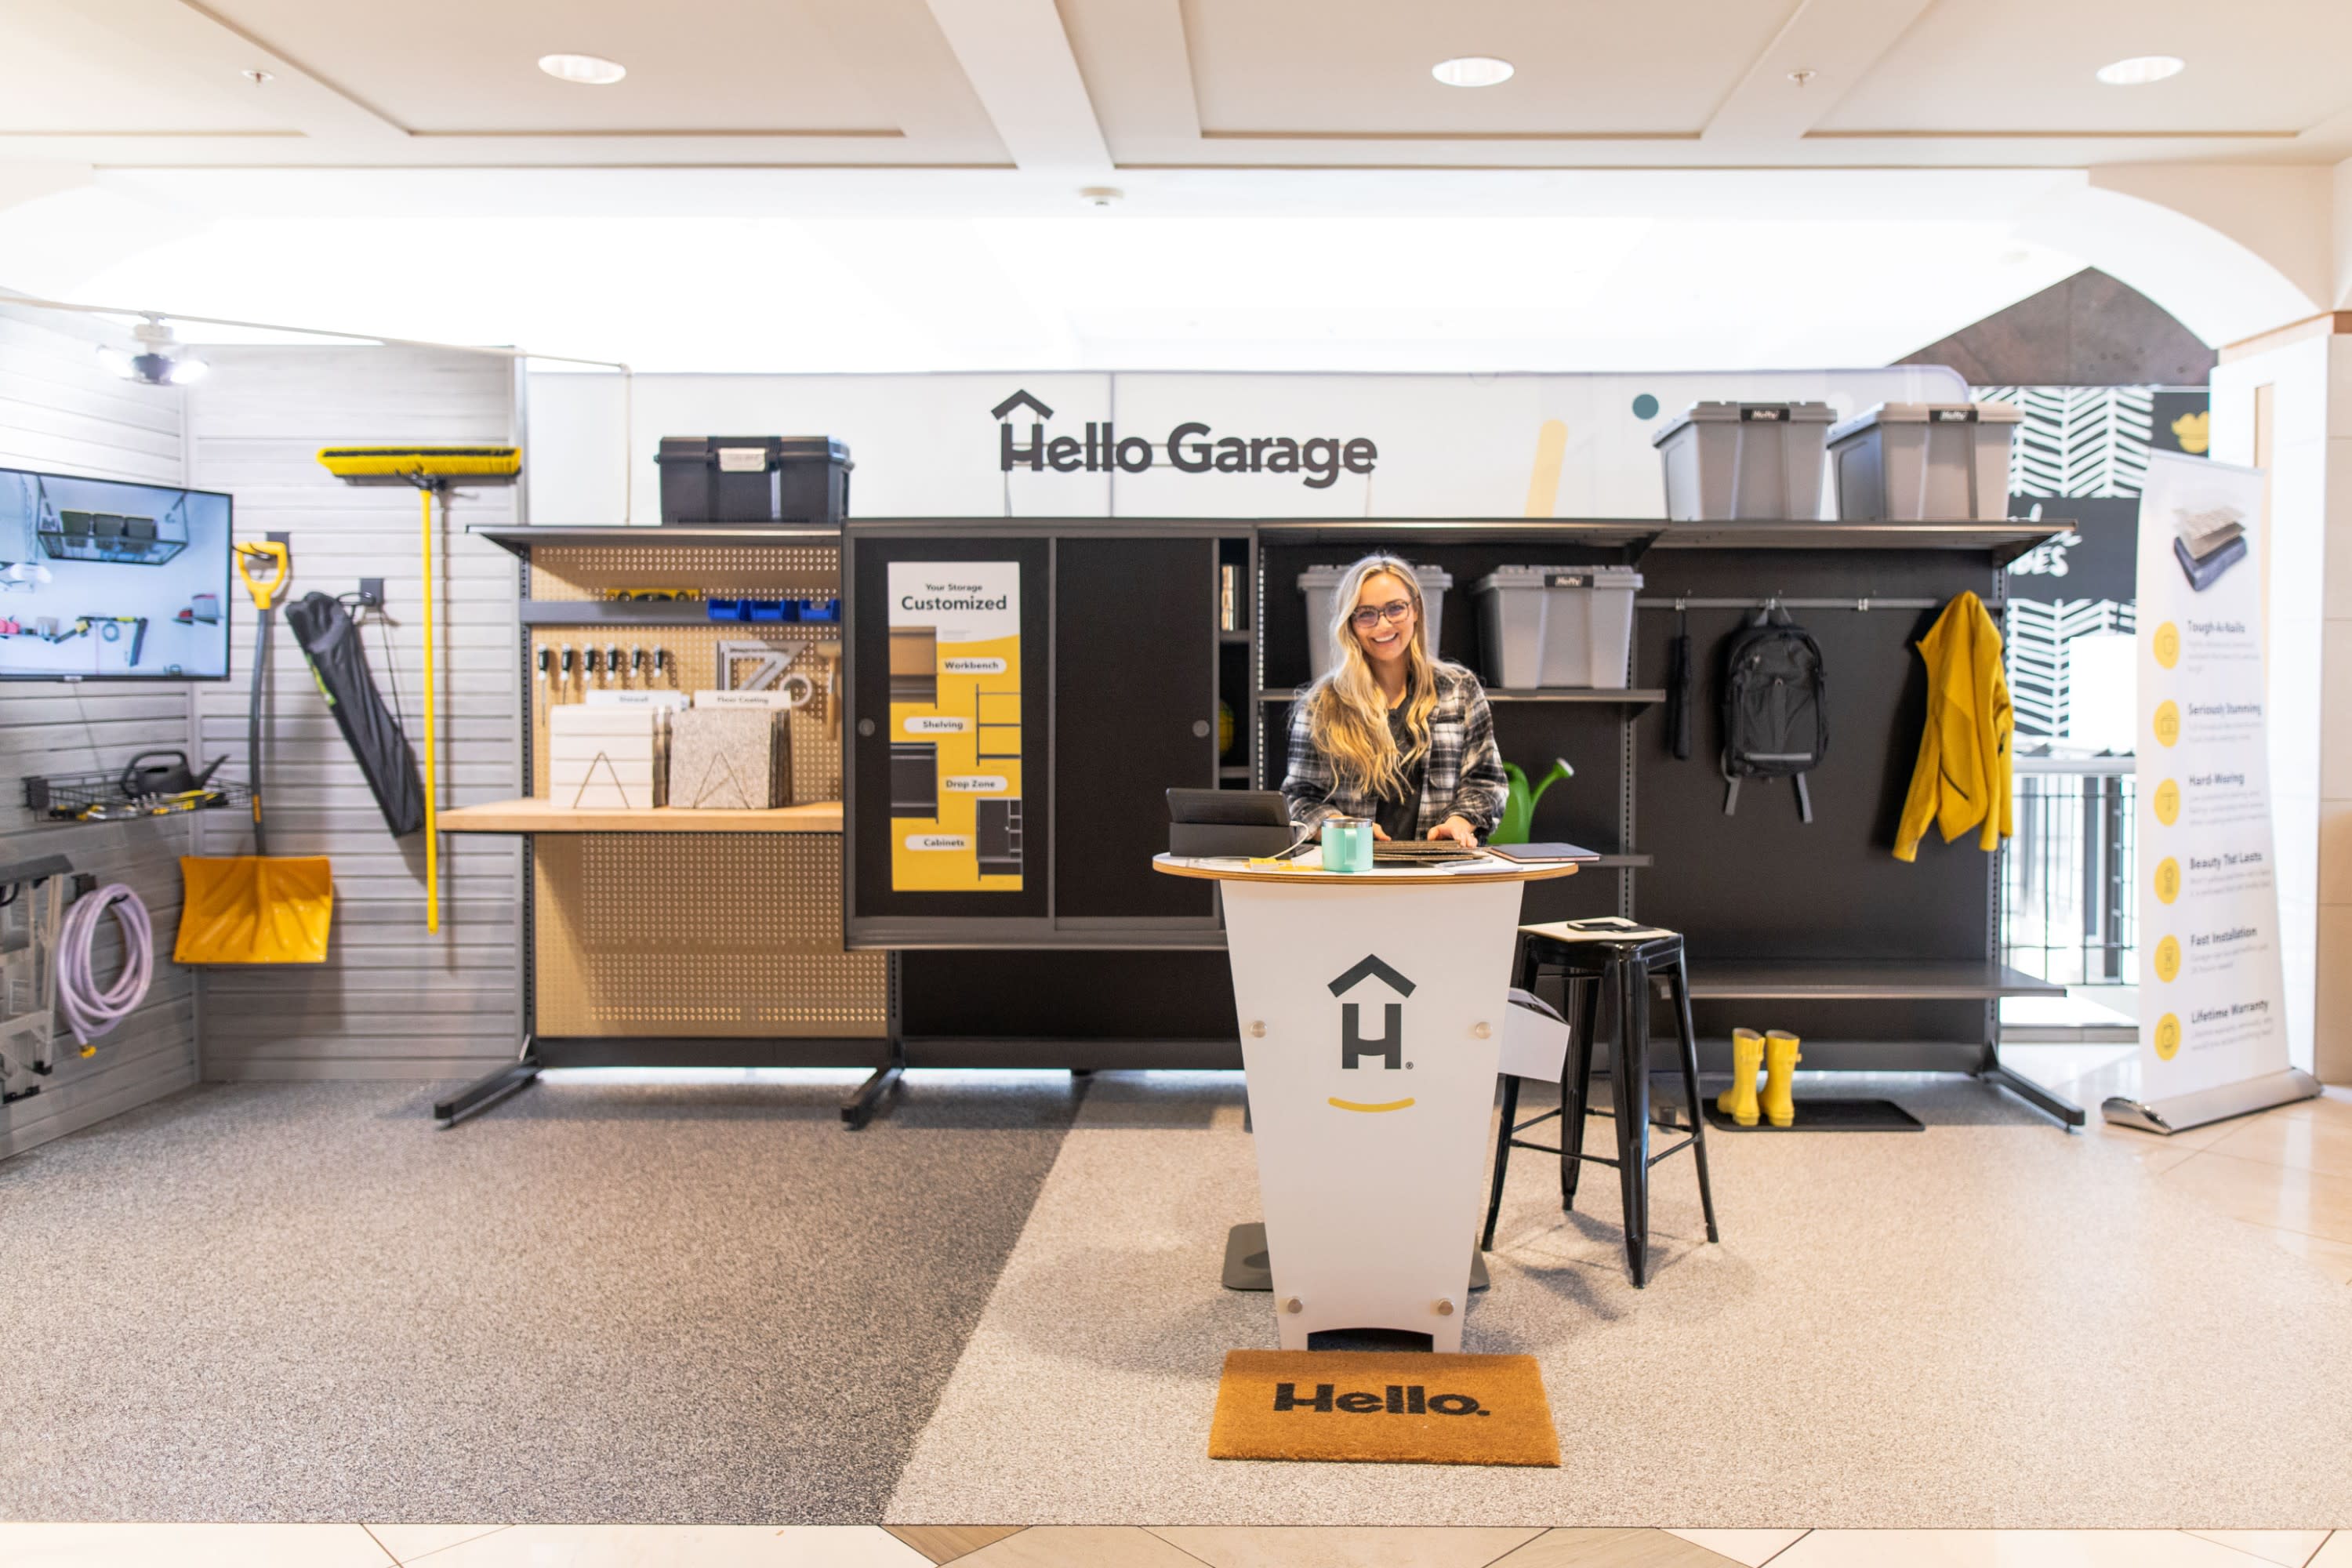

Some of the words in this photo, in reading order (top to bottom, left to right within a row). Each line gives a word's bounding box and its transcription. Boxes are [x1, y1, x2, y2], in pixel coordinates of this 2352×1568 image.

[1000, 422, 1153, 474] Hello
[1167, 422, 1378, 489] Garage
[925, 583, 946, 592] Your
[948, 583, 983, 593] Storage
[902, 595, 1007, 611] Customized
[944, 660, 1000, 670] Workbench
[739, 695, 769, 705] Coating
[922, 720, 964, 731] Shelving
[946, 779, 970, 790] Drop
[971, 779, 996, 789] Zone
[924, 838, 965, 848] Cabinets
[2190, 934, 2210, 946] Fast
[2212, 927, 2258, 943] Installation
[2192, 1009, 2228, 1025] Lifetime
[2230, 1000, 2270, 1017] Warranty
[1273, 1382, 1491, 1417] Hello.
